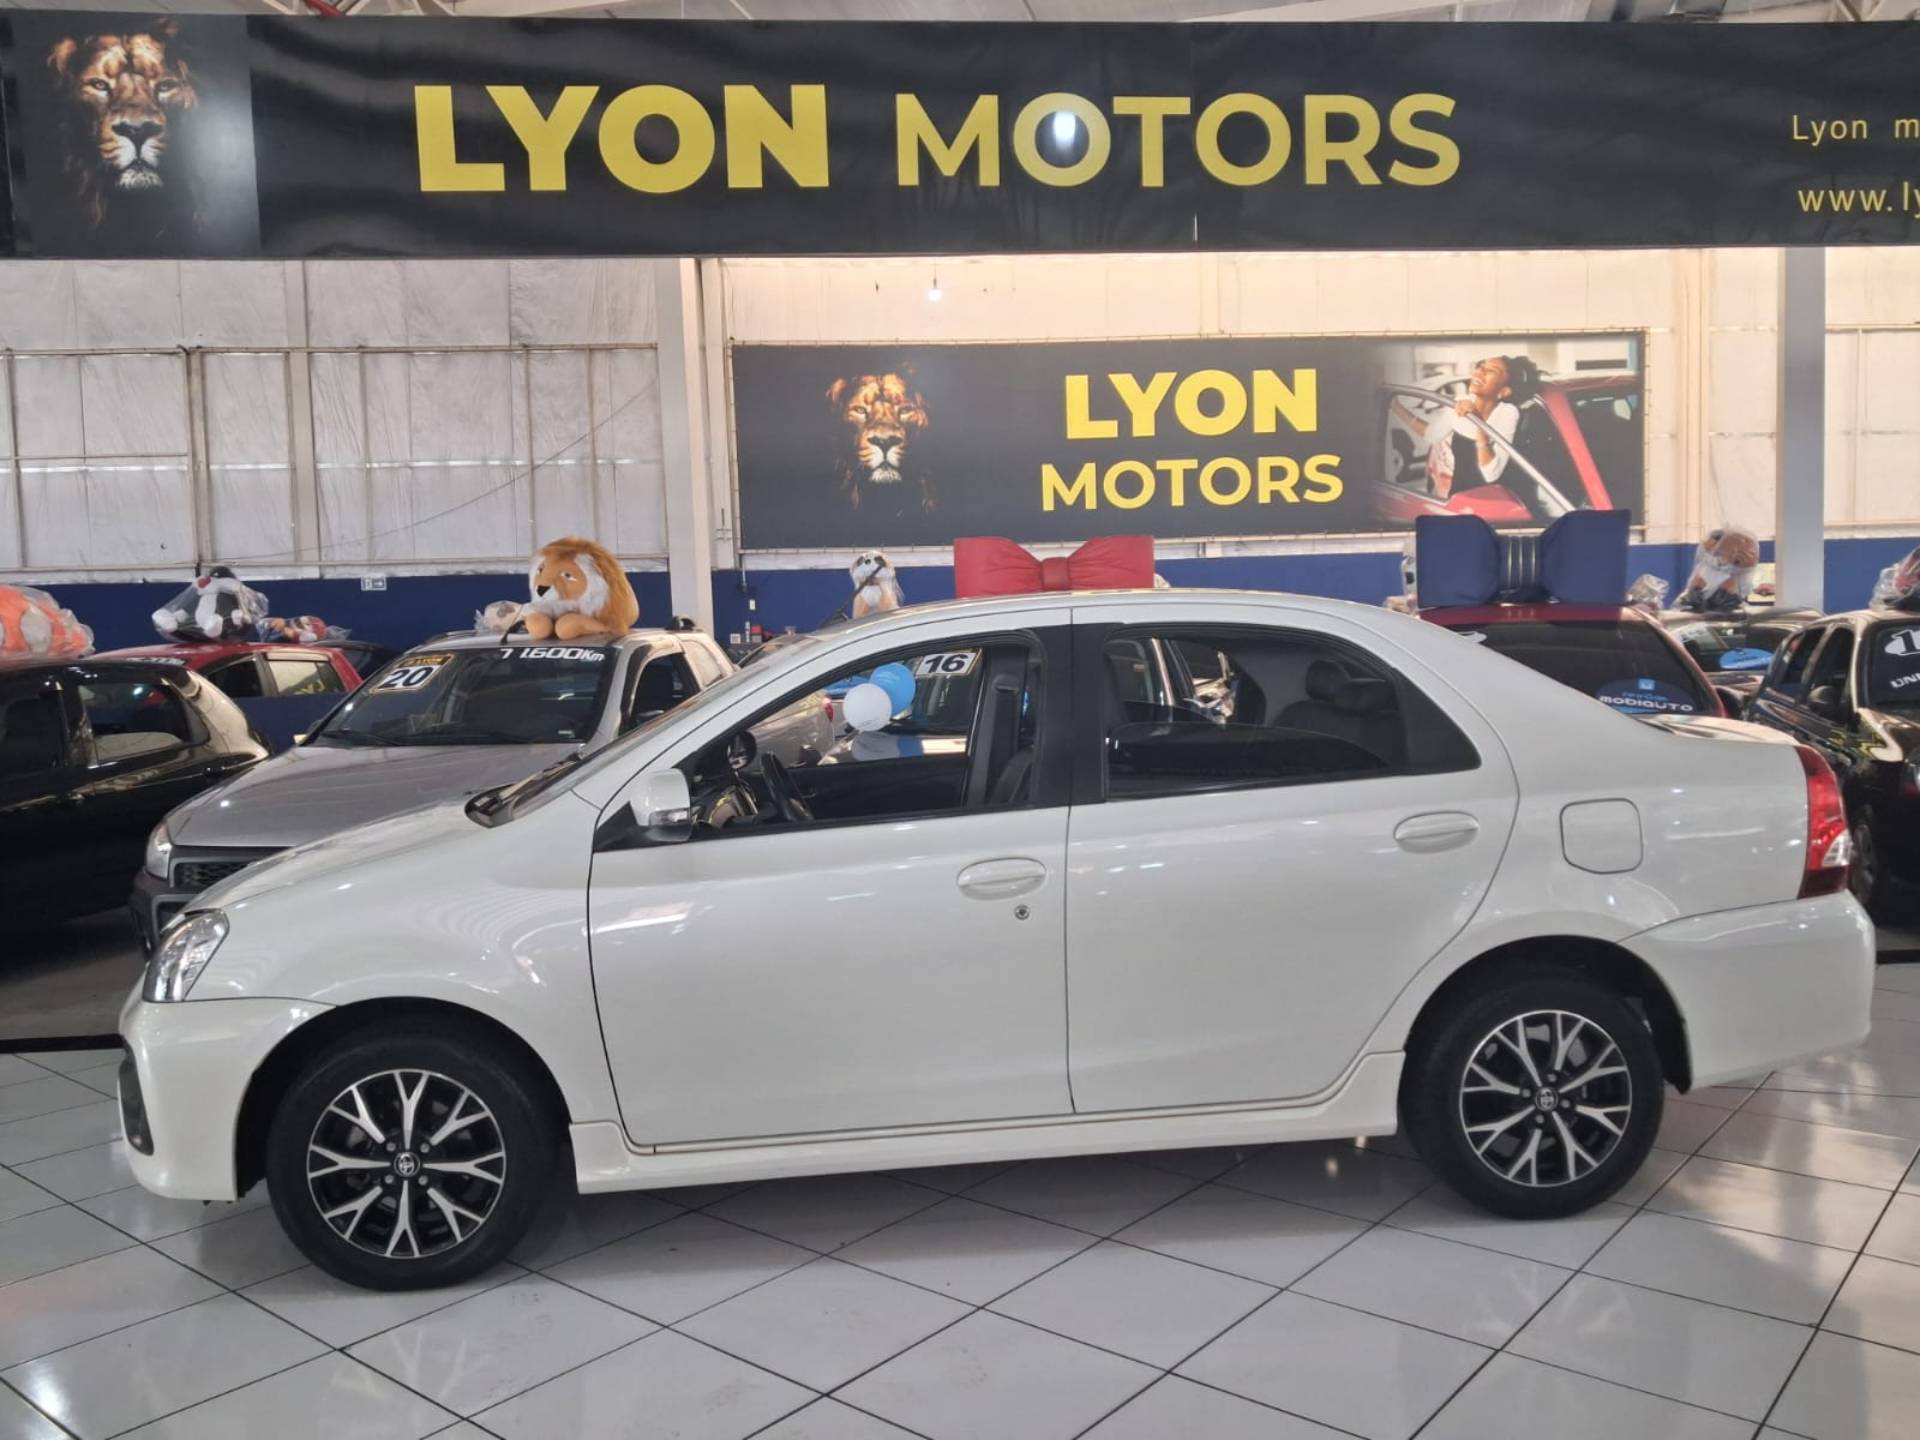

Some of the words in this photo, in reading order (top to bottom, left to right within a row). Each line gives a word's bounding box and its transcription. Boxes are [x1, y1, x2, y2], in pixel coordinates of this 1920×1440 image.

[414, 84, 830, 194] LYON
[896, 92, 1461, 188] MOTORS
[1792, 114, 1868, 147] Lyon
[1065, 368, 1318, 440] LYON
[1041, 454, 1344, 512] MOTORS
[383, 666, 429, 689] 20
[925, 653, 969, 673] 16
